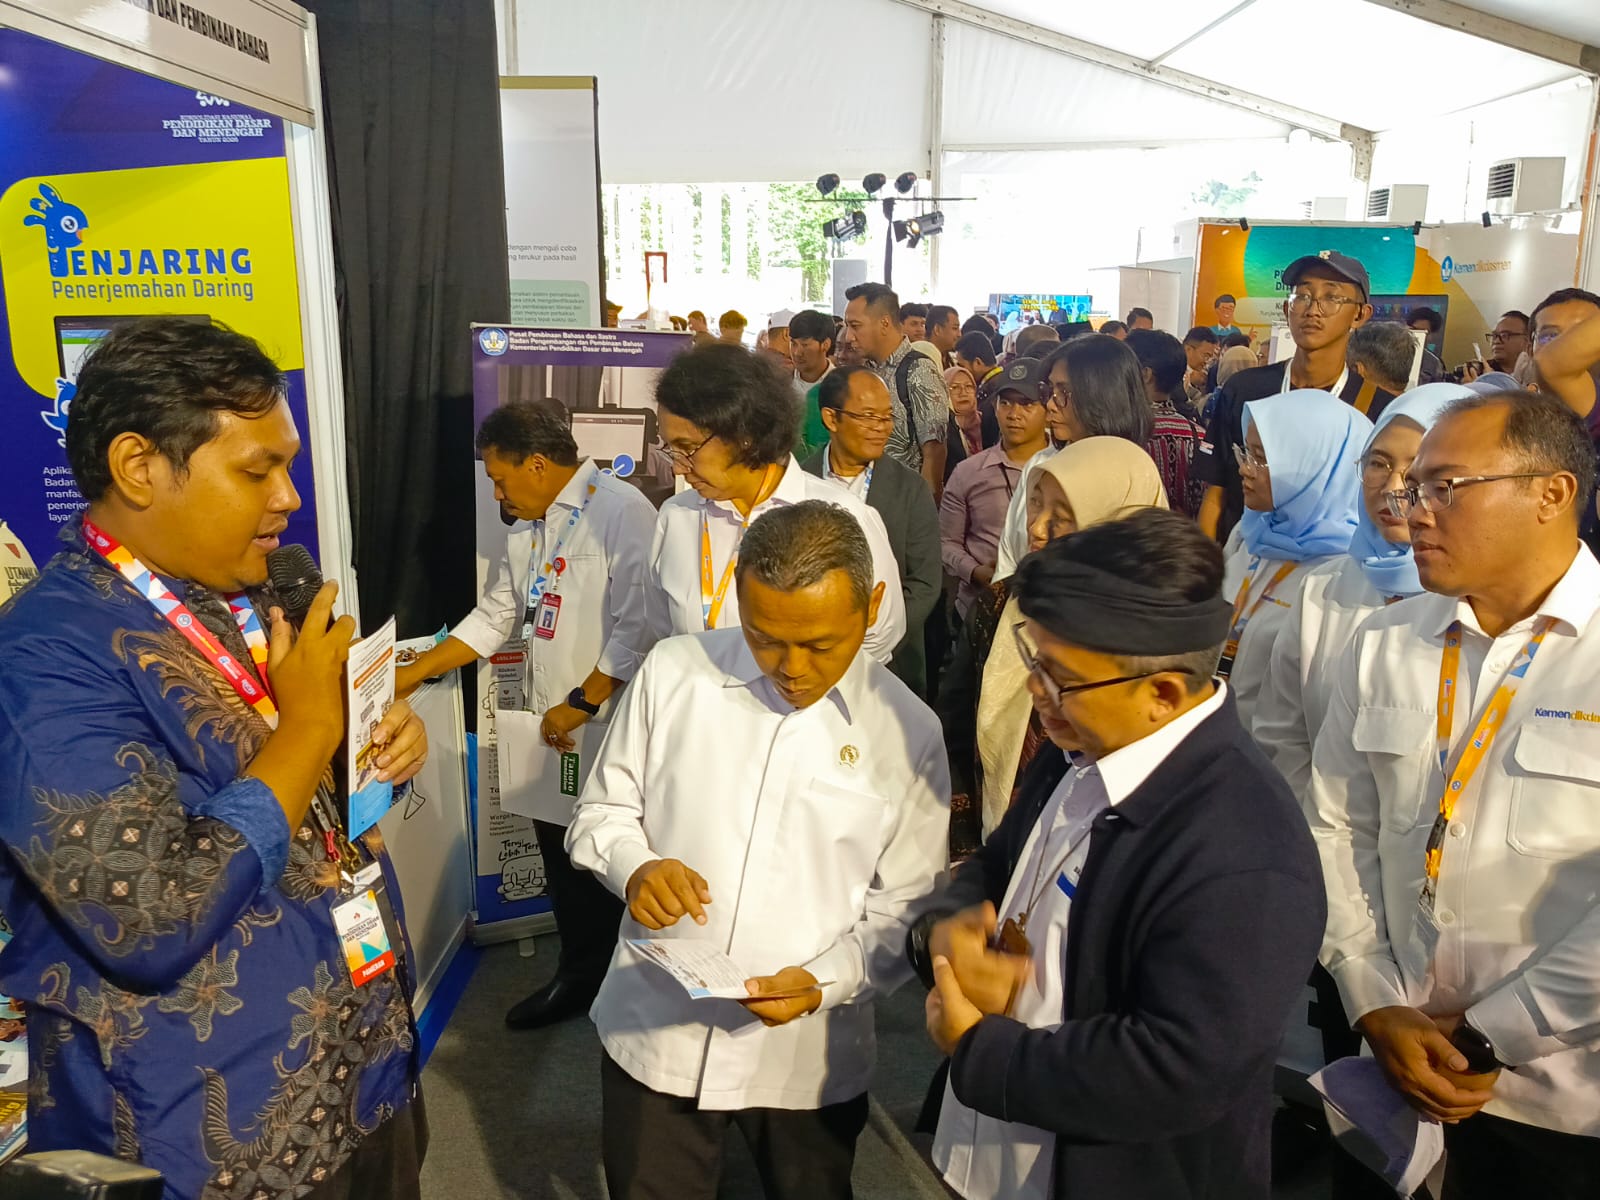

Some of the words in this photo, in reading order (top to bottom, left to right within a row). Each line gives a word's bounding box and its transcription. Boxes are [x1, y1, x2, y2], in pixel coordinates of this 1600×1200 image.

[180, 2, 236, 49] PEMBINAAN
[236, 28, 271, 64] BAHASA
[162, 120, 233, 129] PENDIDIKAN
[235, 119, 271, 128] DASAR
[173, 129, 196, 137] DAN
[199, 128, 263, 137] MENENGAH
[52, 279, 186, 302] Penerjemahan
[193, 278, 254, 301] Daring
[528, 331, 562, 339] Pembinaan
[563, 332, 585, 340] Bahasa
[612, 347, 643, 355] Menengah
[568, 757, 576, 792] Tanoto
